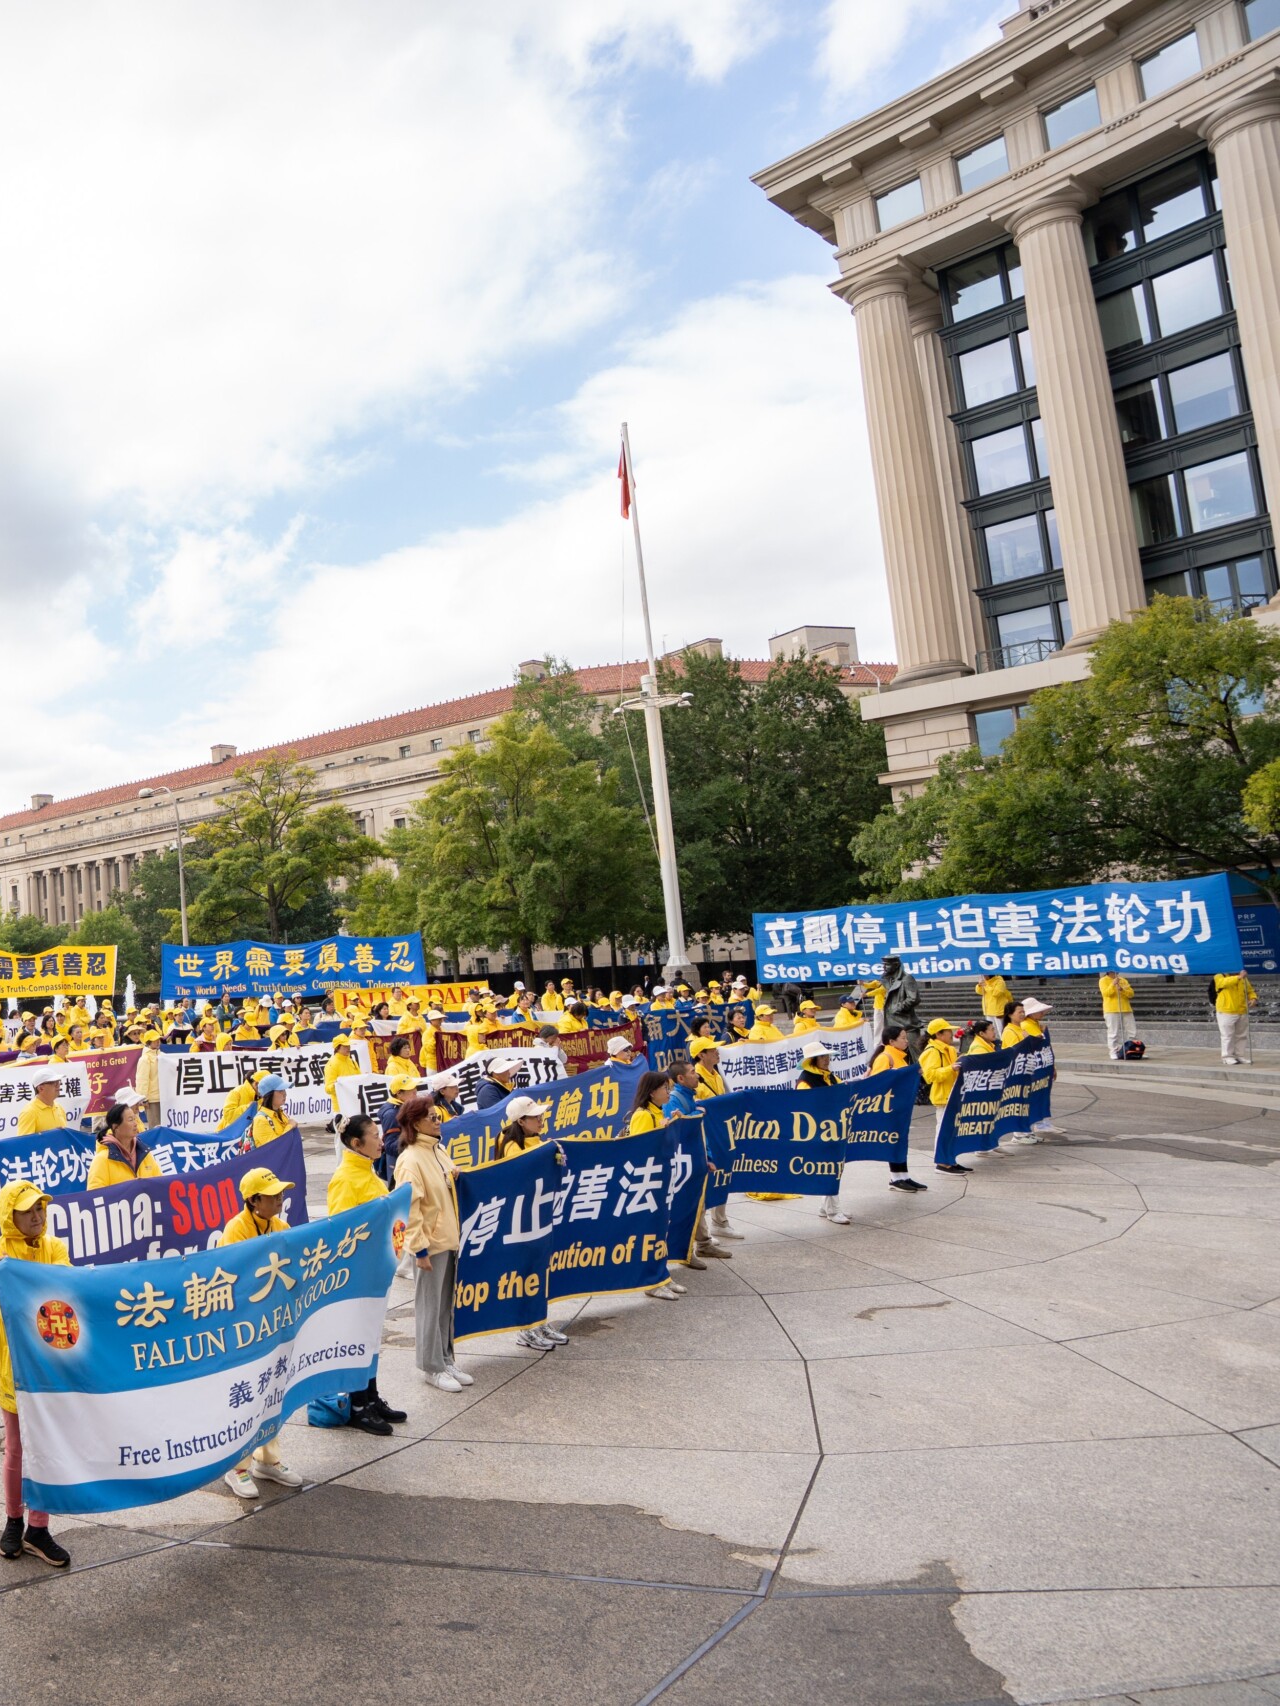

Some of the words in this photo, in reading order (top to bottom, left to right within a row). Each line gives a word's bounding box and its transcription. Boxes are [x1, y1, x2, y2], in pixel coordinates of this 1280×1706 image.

[764, 890, 1213, 956] 立即停止迫害法轮功
[763, 962, 813, 982] Stop
[817, 956, 972, 978] Perseution
[978, 952, 1015, 971] Of
[1026, 951, 1109, 972] Falun
[1115, 948, 1190, 974] Gong
[175, 985, 191, 996] The
[195, 984, 217, 996] World
[222, 983, 247, 994] Needs
[252, 981, 307, 993] Truthfulness
[311, 979, 361, 991] Compassion
[366, 979, 410, 989] Tolerance
[109, 1056, 128, 1066] Great
[442, 1033, 460, 1060] The
[65, 1106, 81, 1122] oil
[166, 1107, 190, 1129] Stop
[284, 1099, 305, 1116] alun
[308, 1096, 333, 1116] Gong
[723, 1111, 781, 1152] Falun
[45, 1192, 164, 1260] China:
[167, 1177, 240, 1236] Stop
[114, 1221, 372, 1328] 法輪大法好
[497, 1270, 540, 1300] the
[611, 1234, 637, 1265] of
[131, 1327, 227, 1373] FALUN
[233, 1301, 294, 1350] DAFA
[304, 1266, 351, 1313] GOOD
[117, 1445, 162, 1467] Free
[165, 1415, 254, 1461] Instruction
[297, 1341, 366, 1371] Exercises
